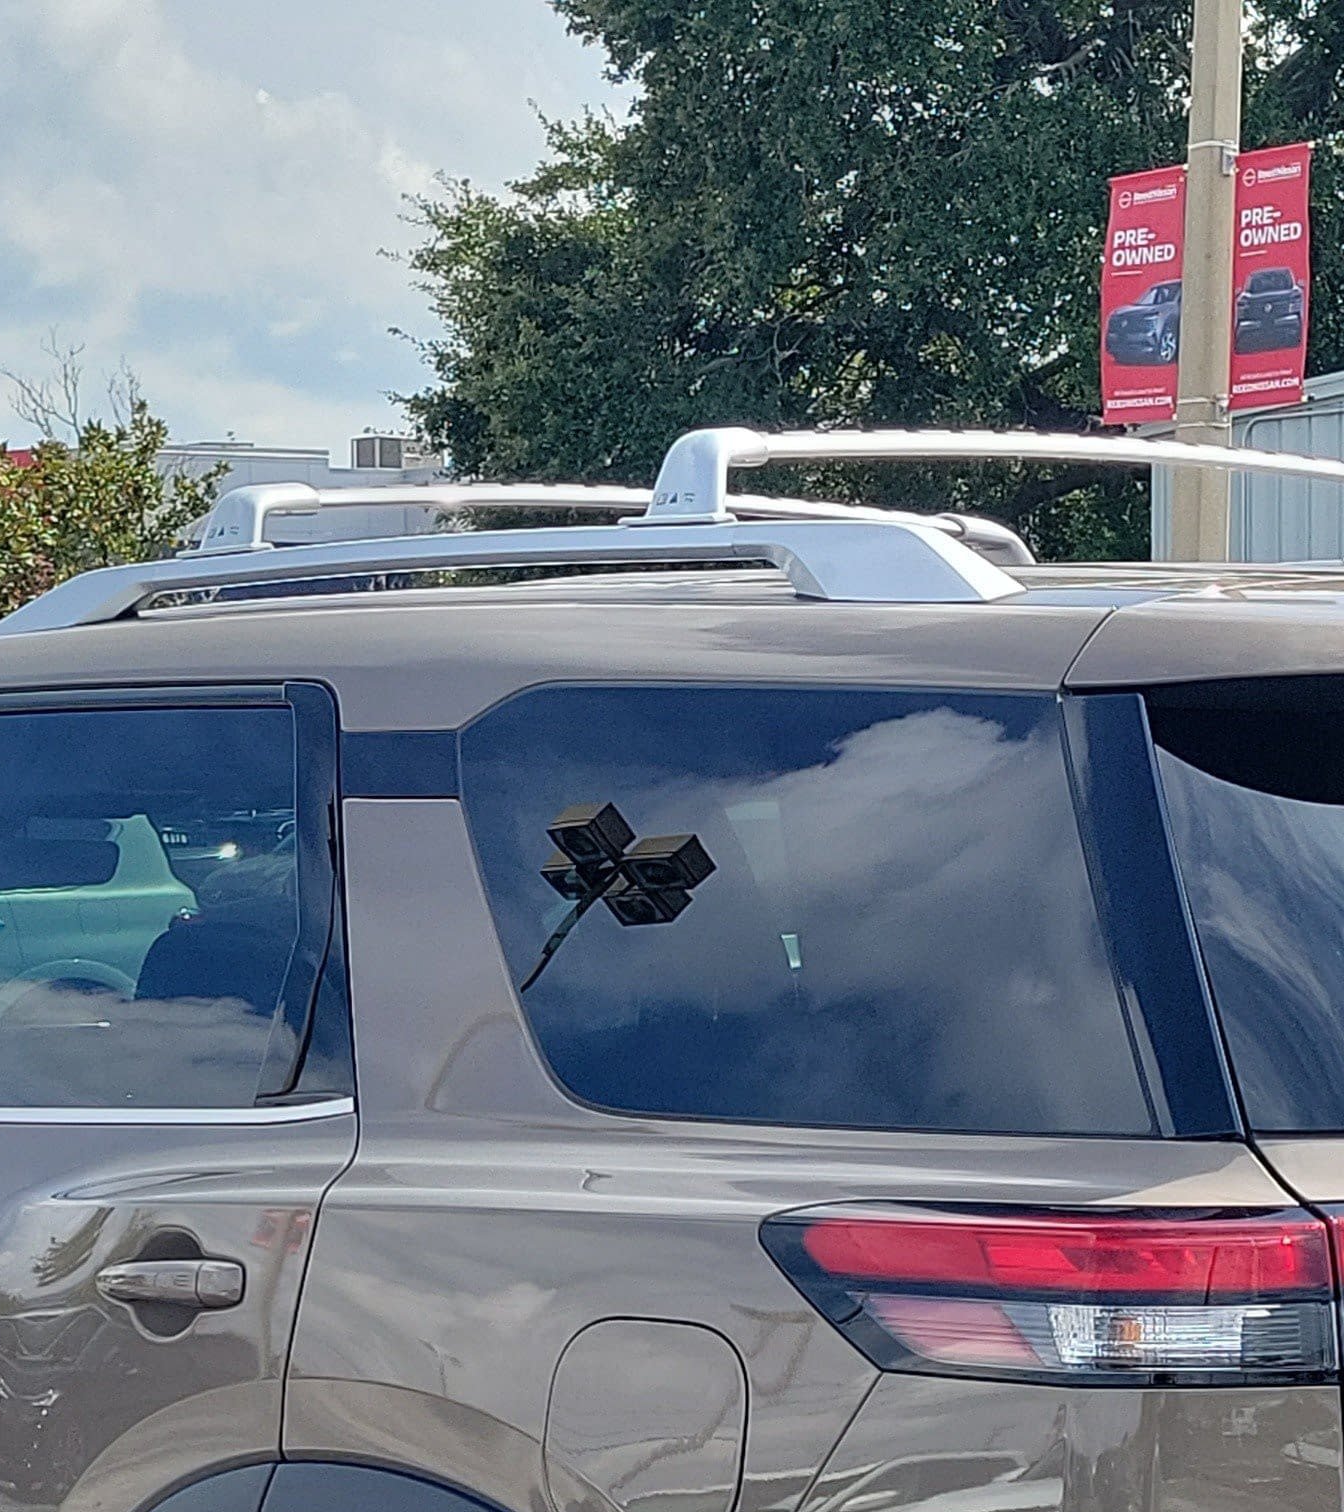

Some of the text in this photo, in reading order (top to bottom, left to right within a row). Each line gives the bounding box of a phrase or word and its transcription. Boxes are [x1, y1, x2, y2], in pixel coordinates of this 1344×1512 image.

[1240, 206, 1282, 228] PRE-
[1113, 228, 1157, 249] PRE-
[1240, 221, 1302, 247] OWNED
[1112, 243, 1176, 267] OWNED
